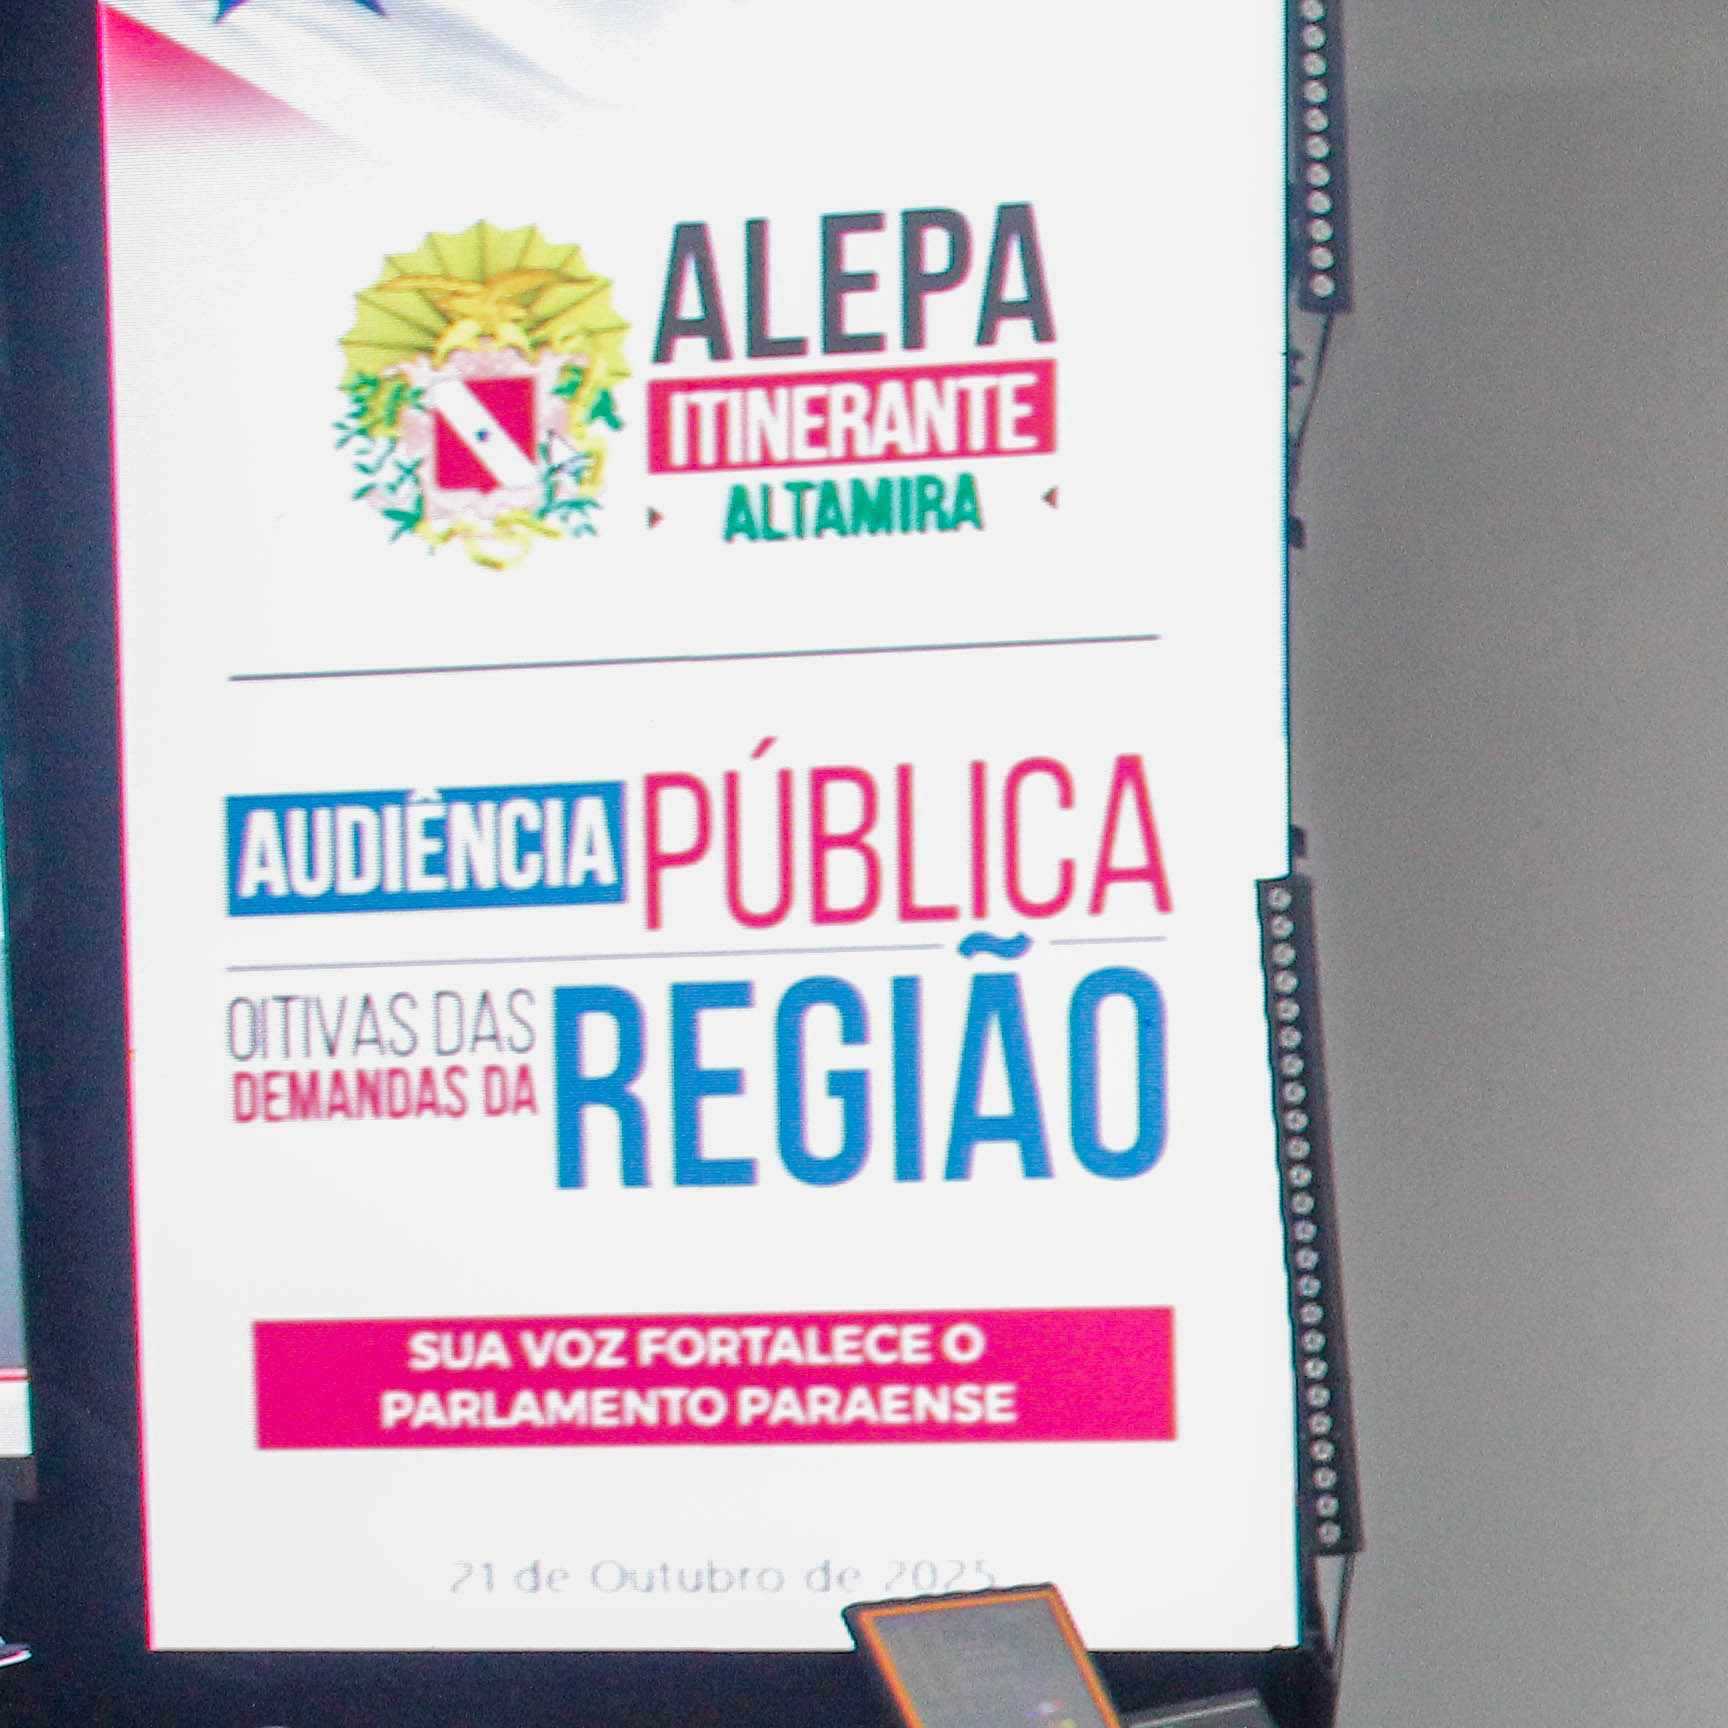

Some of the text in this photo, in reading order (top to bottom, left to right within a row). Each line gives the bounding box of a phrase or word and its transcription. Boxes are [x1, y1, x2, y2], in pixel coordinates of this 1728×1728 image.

[652, 202, 1057, 363] ALEPA
[670, 372, 1039, 467] ITINERANTE
[723, 471, 984, 543] ALTAMIRA
[237, 735, 1174, 932] AUDIÊNCIA PÚBLICA
[226, 987, 536, 1061] OITIVAS DAS
[232, 1064, 539, 1122] DEMANDAS DA
[552, 931, 1170, 1191] REGIÃO
[407, 1322, 986, 1370] SUA VOZ FORTALECE O
[380, 1382, 1018, 1429] PARLAMENTO PARAENSE
[448, 1558, 997, 1594] 21 de Outubro de 2025
